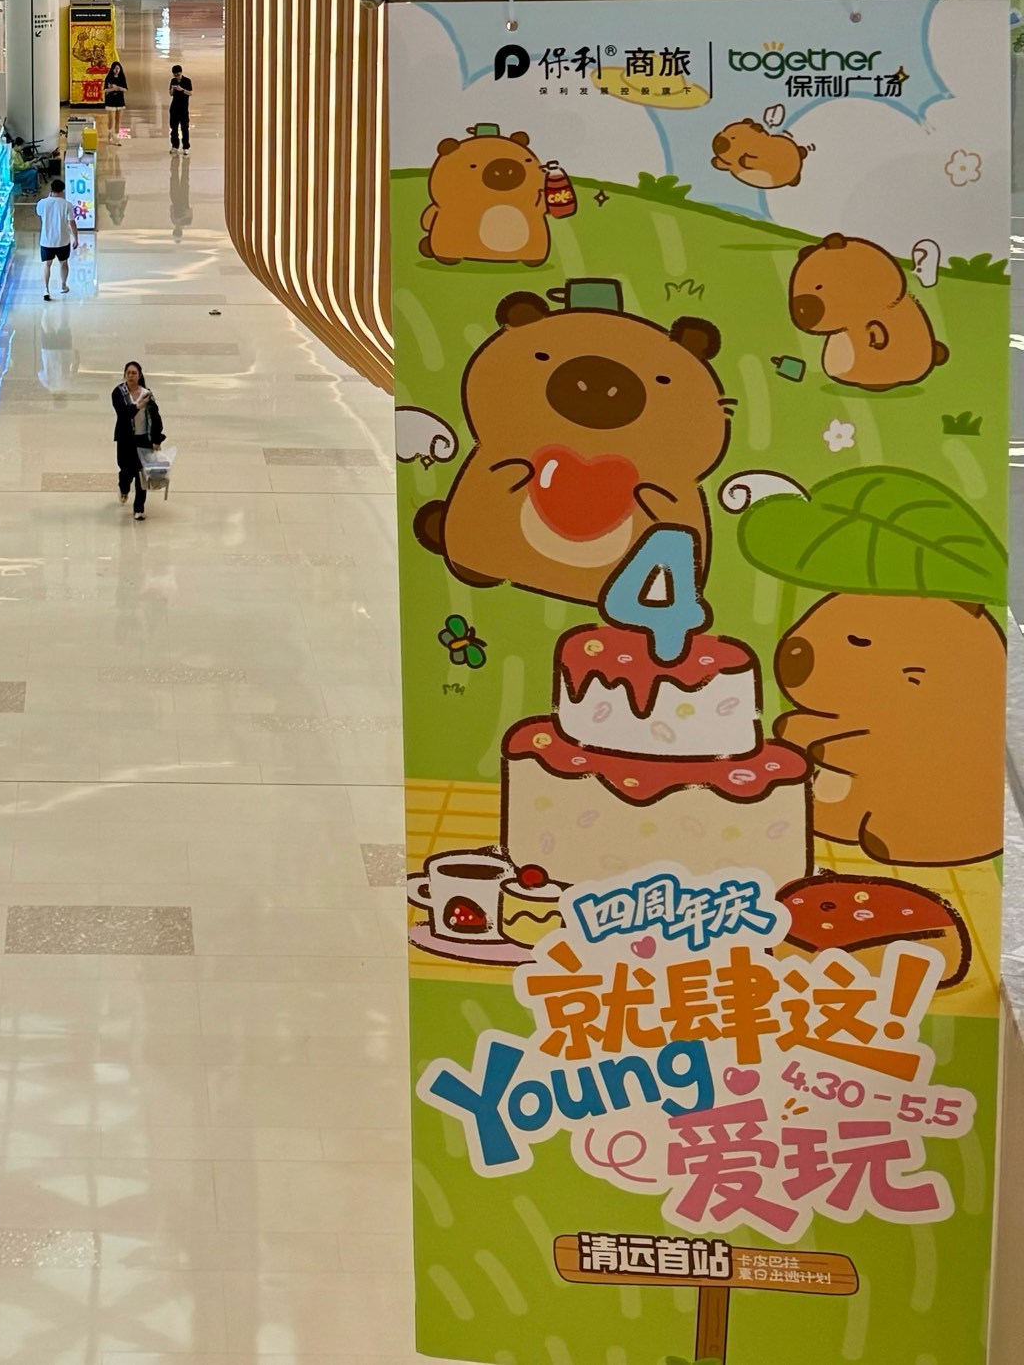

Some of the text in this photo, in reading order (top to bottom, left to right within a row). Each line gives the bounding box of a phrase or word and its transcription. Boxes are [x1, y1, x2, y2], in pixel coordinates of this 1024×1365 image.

[625, 47, 691, 76] 商旅
[729, 47, 882, 79] together
[786, 74, 905, 98] 保利广场
[579, 875, 774, 948] 四周年庆
[527, 941, 930, 1082] 就肆这!
[430, 1040, 715, 1166] Young
[668, 1098, 940, 1233] 爱玩
[581, 1235, 730, 1278] 清远首站
[737, 1255, 800, 1269] 卡皮巴拉
